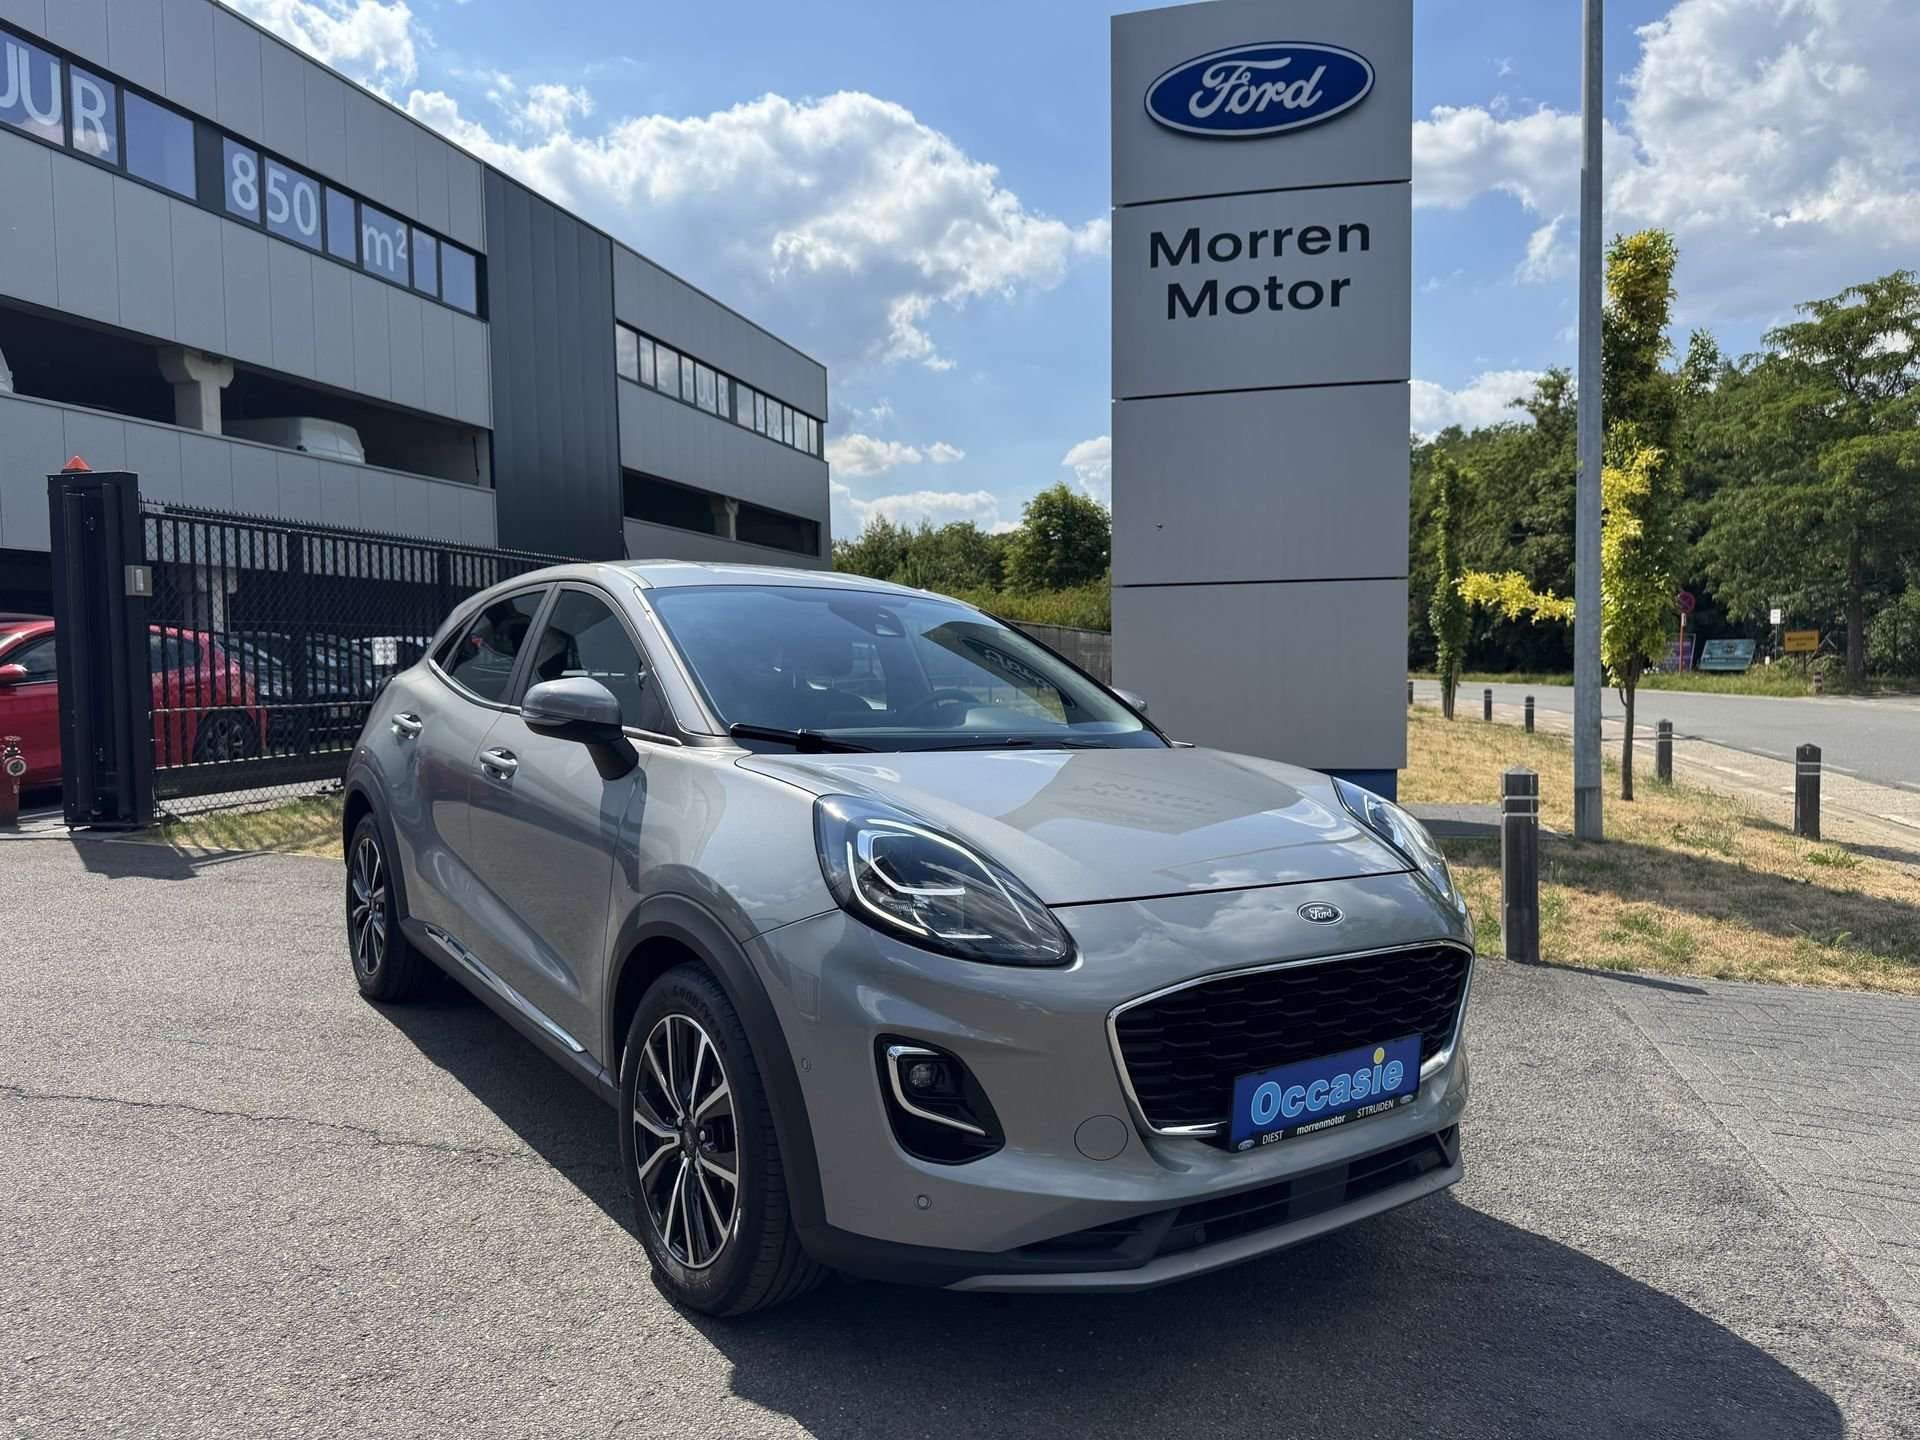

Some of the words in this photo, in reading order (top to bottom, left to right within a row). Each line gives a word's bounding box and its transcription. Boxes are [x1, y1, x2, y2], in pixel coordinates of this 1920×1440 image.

[1189, 57, 1327, 118] Ford
[232, 153, 317, 236] 850
[1150, 222, 1370, 268] Morren
[1167, 275, 1350, 320] Motor
[1250, 1047, 1404, 1125] Occasie
[1262, 1130, 1284, 1144] DIEST
[1296, 1114, 1346, 1135] morrenmotor
